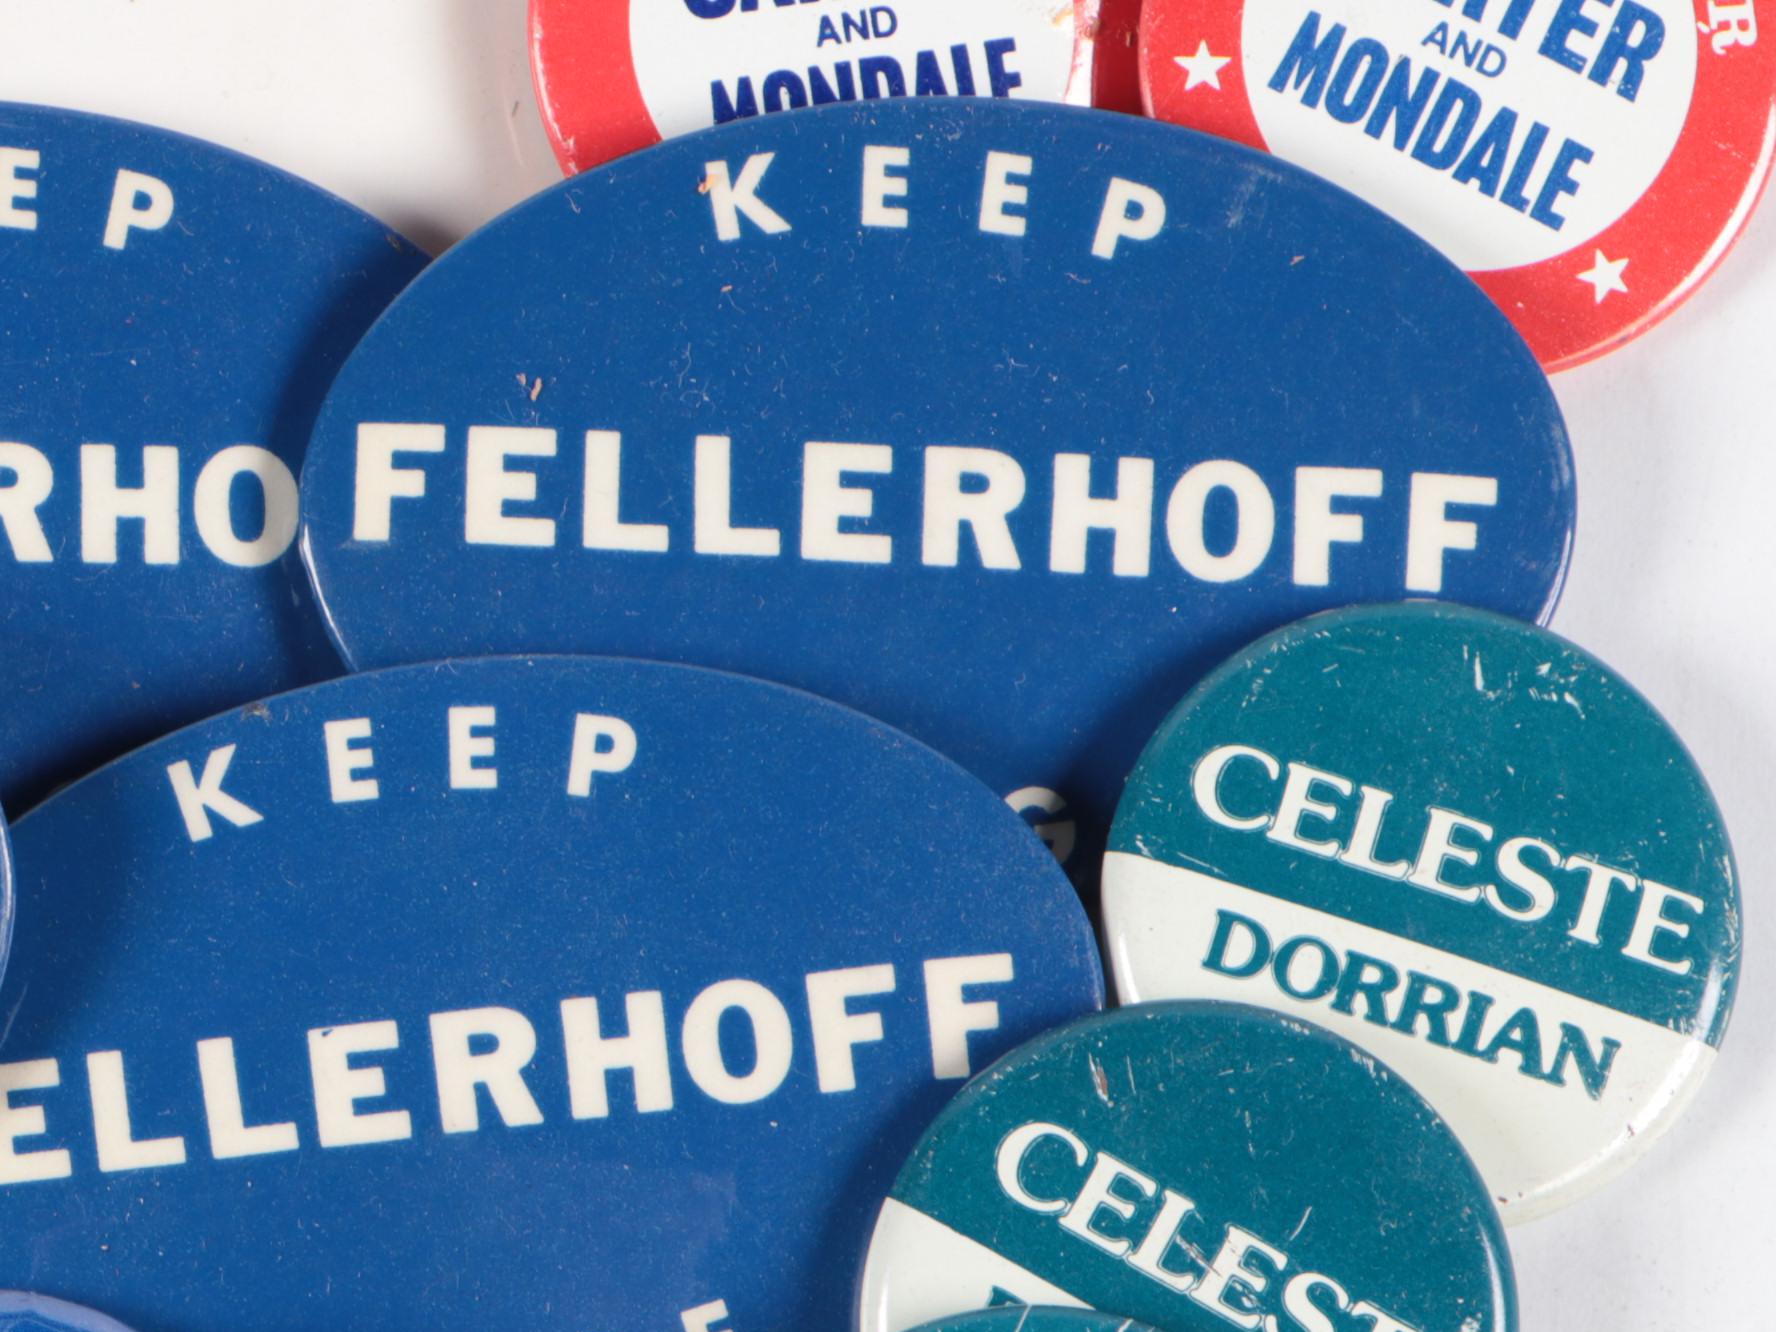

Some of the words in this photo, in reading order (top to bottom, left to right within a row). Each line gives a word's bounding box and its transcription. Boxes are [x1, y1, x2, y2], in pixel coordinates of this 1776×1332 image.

[817, 6, 897, 47] AND
[1421, 21, 1508, 78] AND
[1267, 10, 1595, 232] MONDALE
[704, 145, 1166, 259] KEEP
[353, 423, 1498, 592] FELLERHOFF
[167, 706, 638, 843] KEEP
[1192, 745, 1704, 975] CELESTE
[1202, 909, 1621, 1101] DORRIAN
